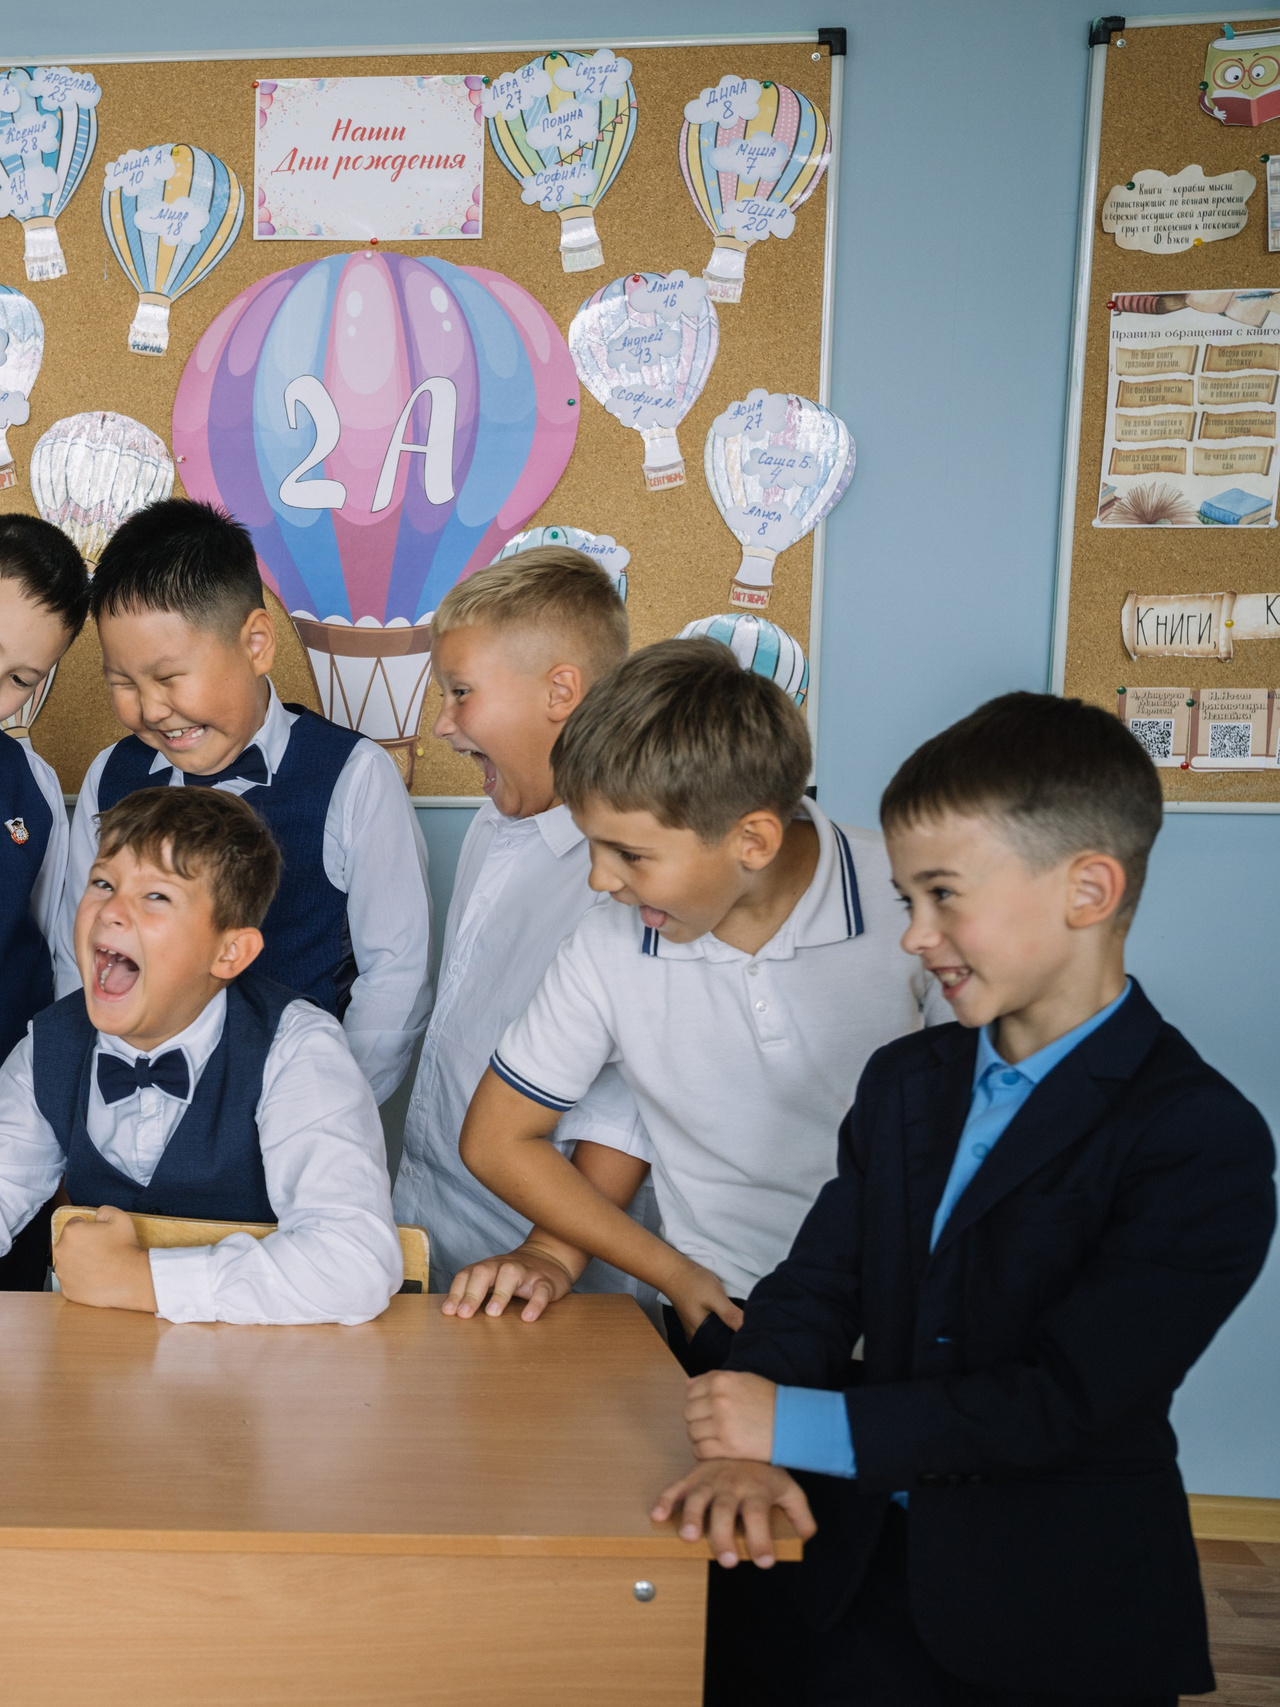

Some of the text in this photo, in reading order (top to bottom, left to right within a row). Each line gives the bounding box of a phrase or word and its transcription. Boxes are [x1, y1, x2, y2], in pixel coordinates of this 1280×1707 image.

[584, 76, 608, 94] 21
[47, 86, 72, 103] 25
[505, 90, 522, 110] 27
[722, 100, 734, 119] 8
[331, 118, 407, 142] Наши
[557, 124, 573, 141] 12
[20, 137, 39, 154] 28
[270, 147, 467, 183] Дни рождения
[746, 156, 758, 175] 7
[129, 170, 144, 187] 10
[16, 190, 29, 205] 31
[542, 185, 565, 202] 28
[1139, 183, 1162, 195] Книги
[166, 222, 183, 236] 18
[742, 217, 768, 231] 20
[663, 295, 677, 308] 16
[1111, 330, 1161, 341] Правила
[1165, 329, 1233, 340] обращения
[1246, 328, 1280, 336] книго
[637, 347, 652, 365] 13
[633, 406, 642, 419] 1
[744, 413, 764, 431] 27
[278, 374, 458, 514] 2 А
[649, 472, 684, 488] СЕНТЯБРЬ
[770, 466, 783, 484] 4
[757, 522, 768, 535] 8
[732, 592, 767, 605] ОКТЯБРЬ
